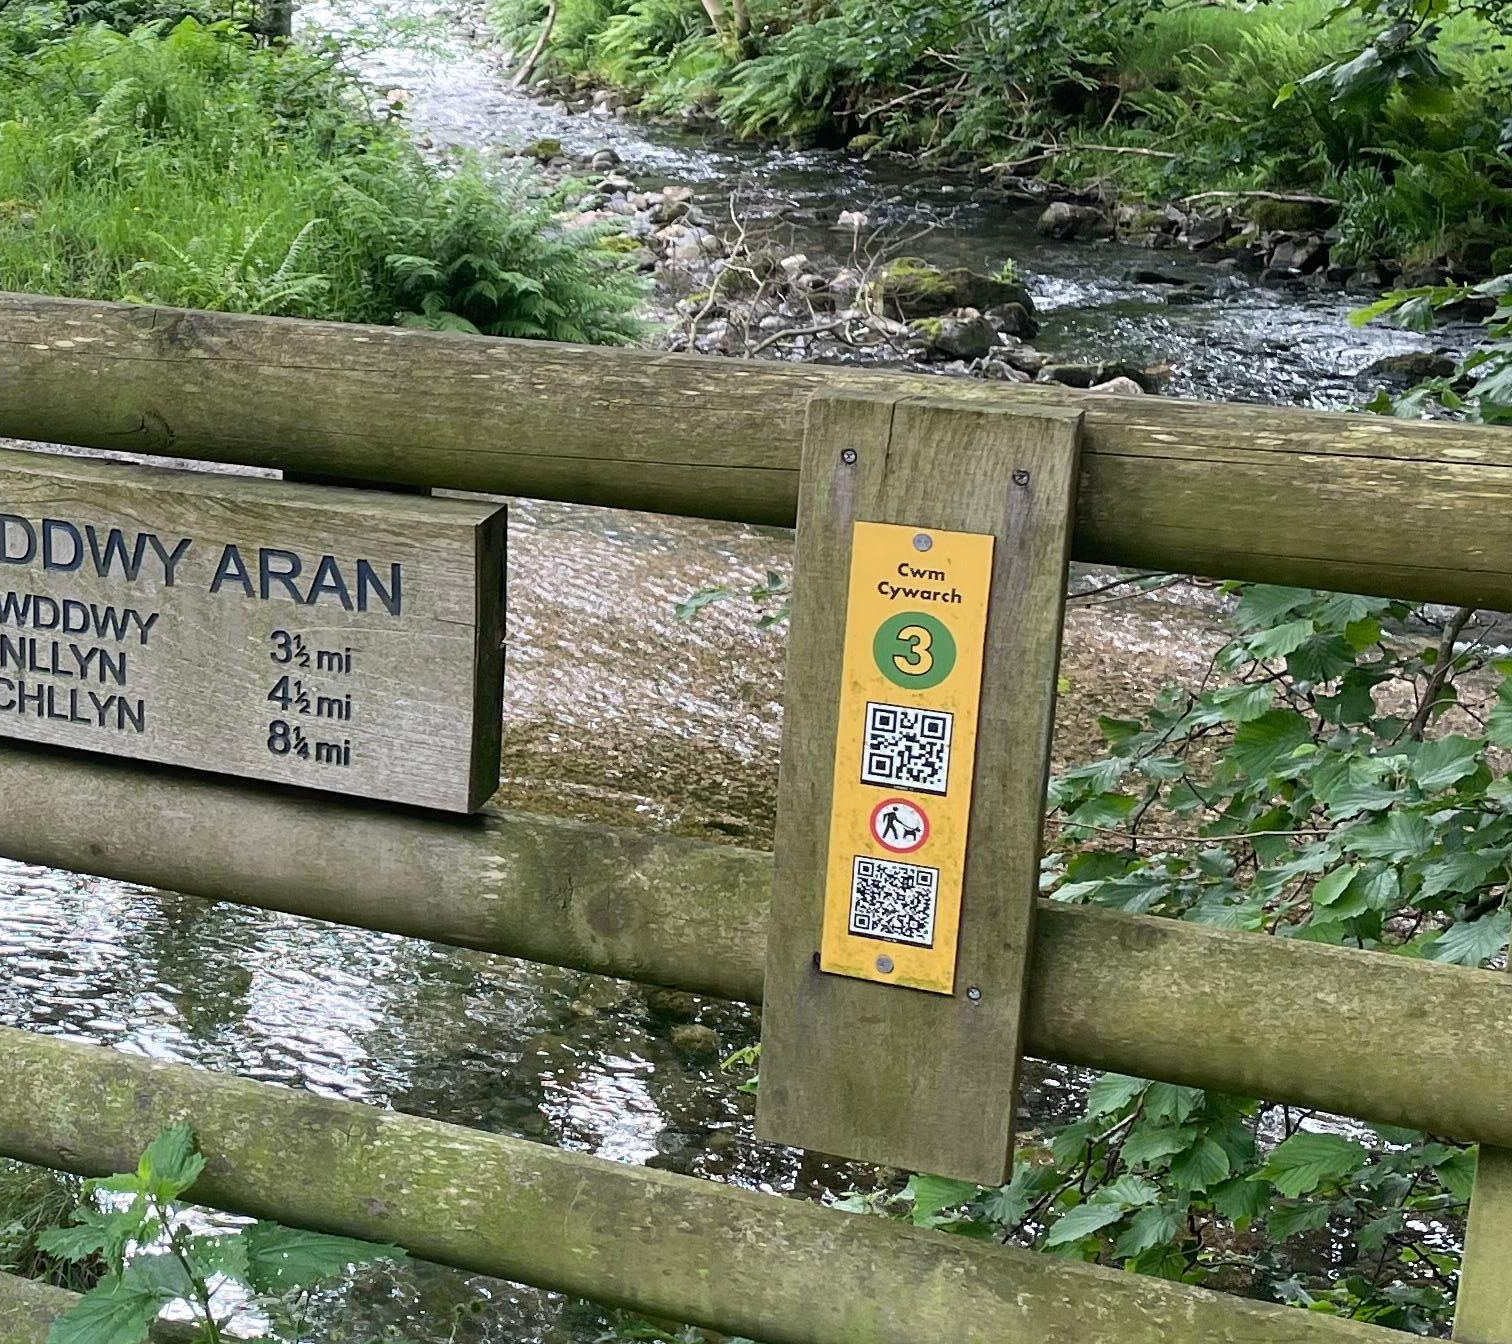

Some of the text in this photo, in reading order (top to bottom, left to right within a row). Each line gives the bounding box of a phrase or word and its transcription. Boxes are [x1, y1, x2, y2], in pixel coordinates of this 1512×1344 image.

[208, 543, 402, 617] ARAN
[897, 562, 945, 582] Cwm
[877, 581, 962, 604] Cywarch
[317, 647, 352, 674] mi
[892, 624, 935, 677] 3
[317, 694, 351, 721] mi
[315, 739, 351, 766] mi
